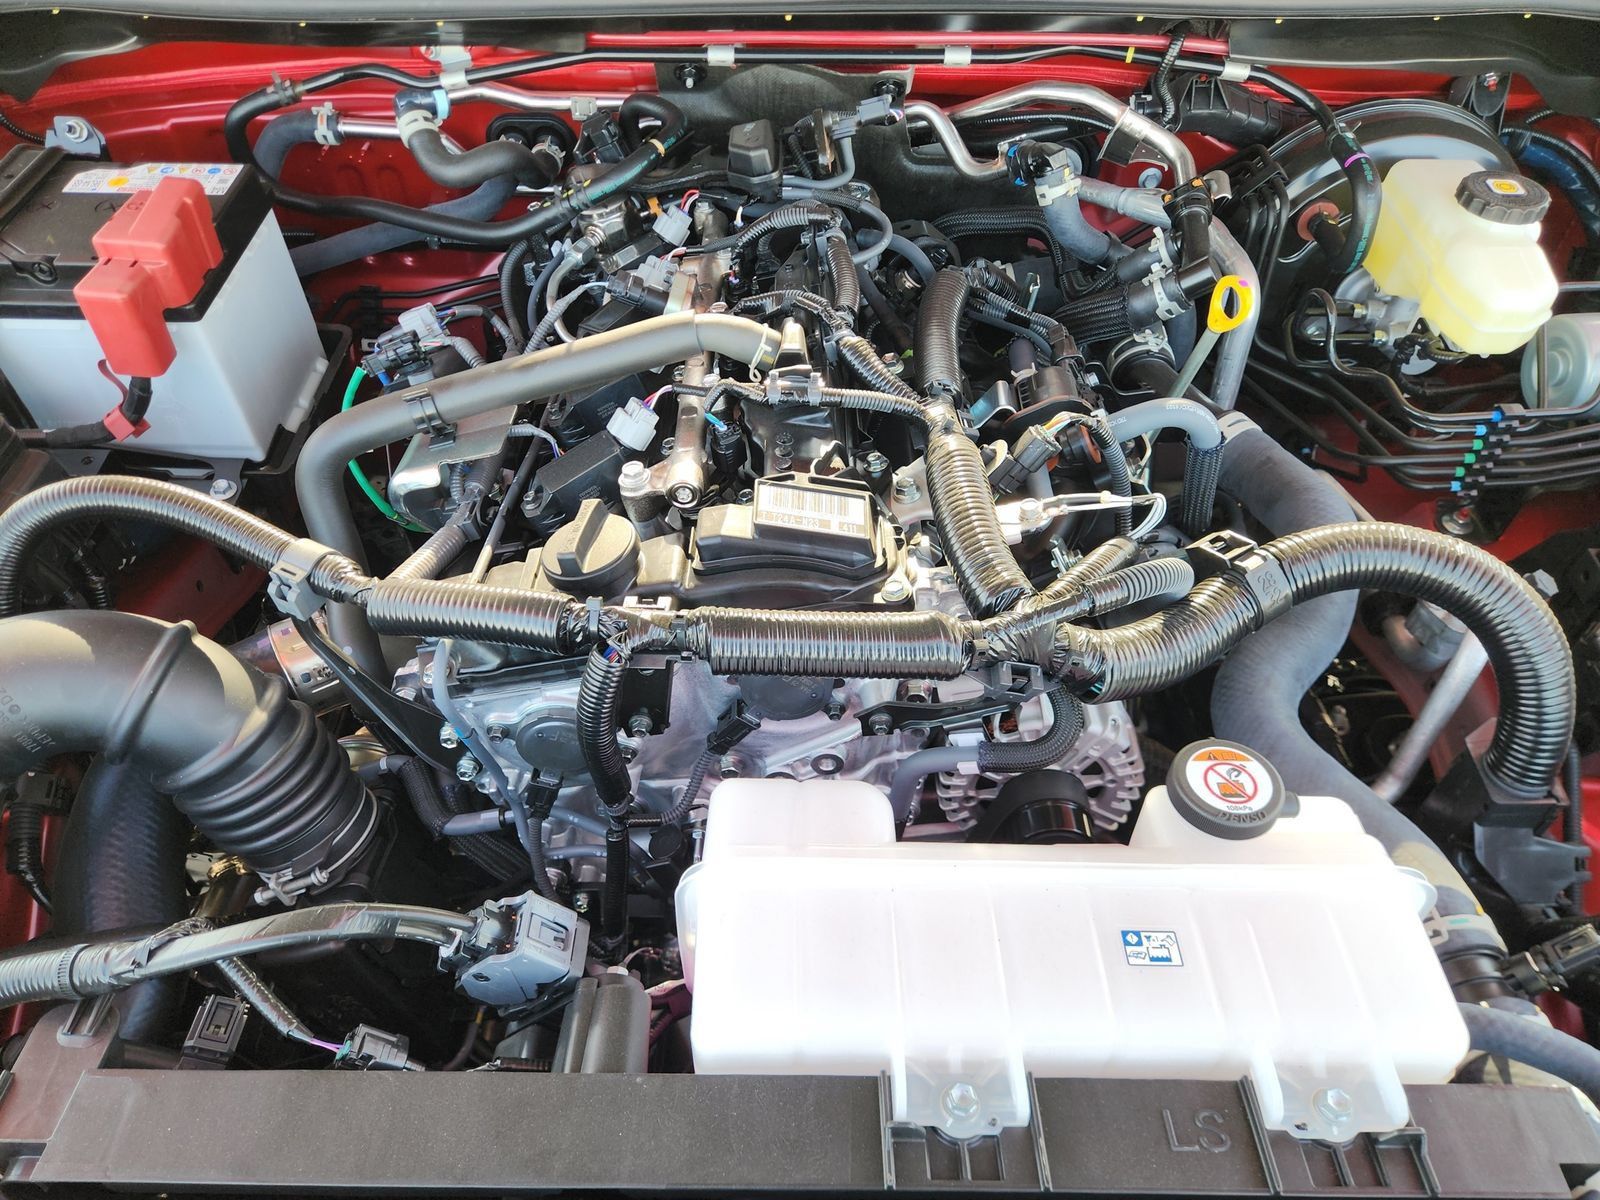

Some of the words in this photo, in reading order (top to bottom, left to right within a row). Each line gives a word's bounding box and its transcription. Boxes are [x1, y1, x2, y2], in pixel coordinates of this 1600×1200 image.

[1258, 571, 1276, 592] 28
[1218, 810, 1268, 824] DENSO
[1162, 1108, 1232, 1153] LS
